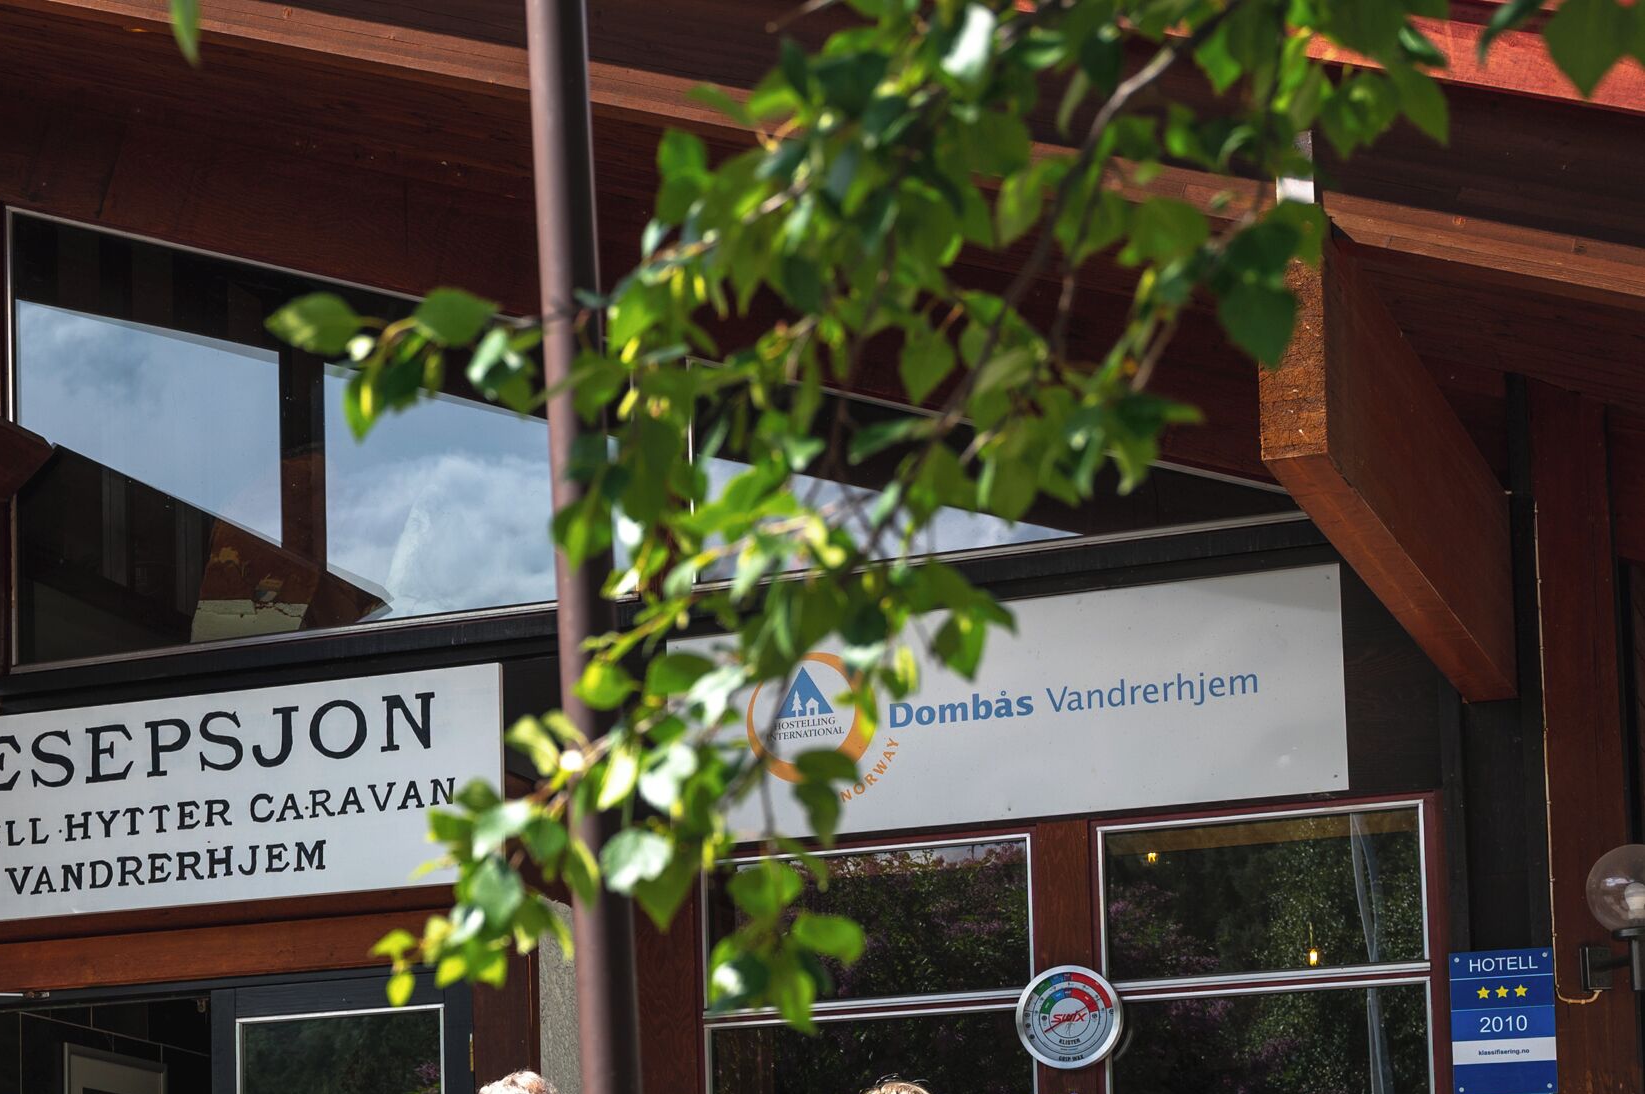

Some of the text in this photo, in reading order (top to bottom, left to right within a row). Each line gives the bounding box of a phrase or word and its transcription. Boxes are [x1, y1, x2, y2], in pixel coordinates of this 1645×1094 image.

[773, 716, 836, 731] HOSTELLING
[889, 672, 1259, 729] Dombås Vandrerhjem
[839, 737, 900, 803] NORWAY
[64, 798, 233, 842] HYTTER
[249, 776, 456, 823] CARAVAN
[4, 840, 327, 895] VANDRERHJEM
[1469, 956, 1538, 972] HOTELL
[1480, 1015, 1528, 1033] 2010
